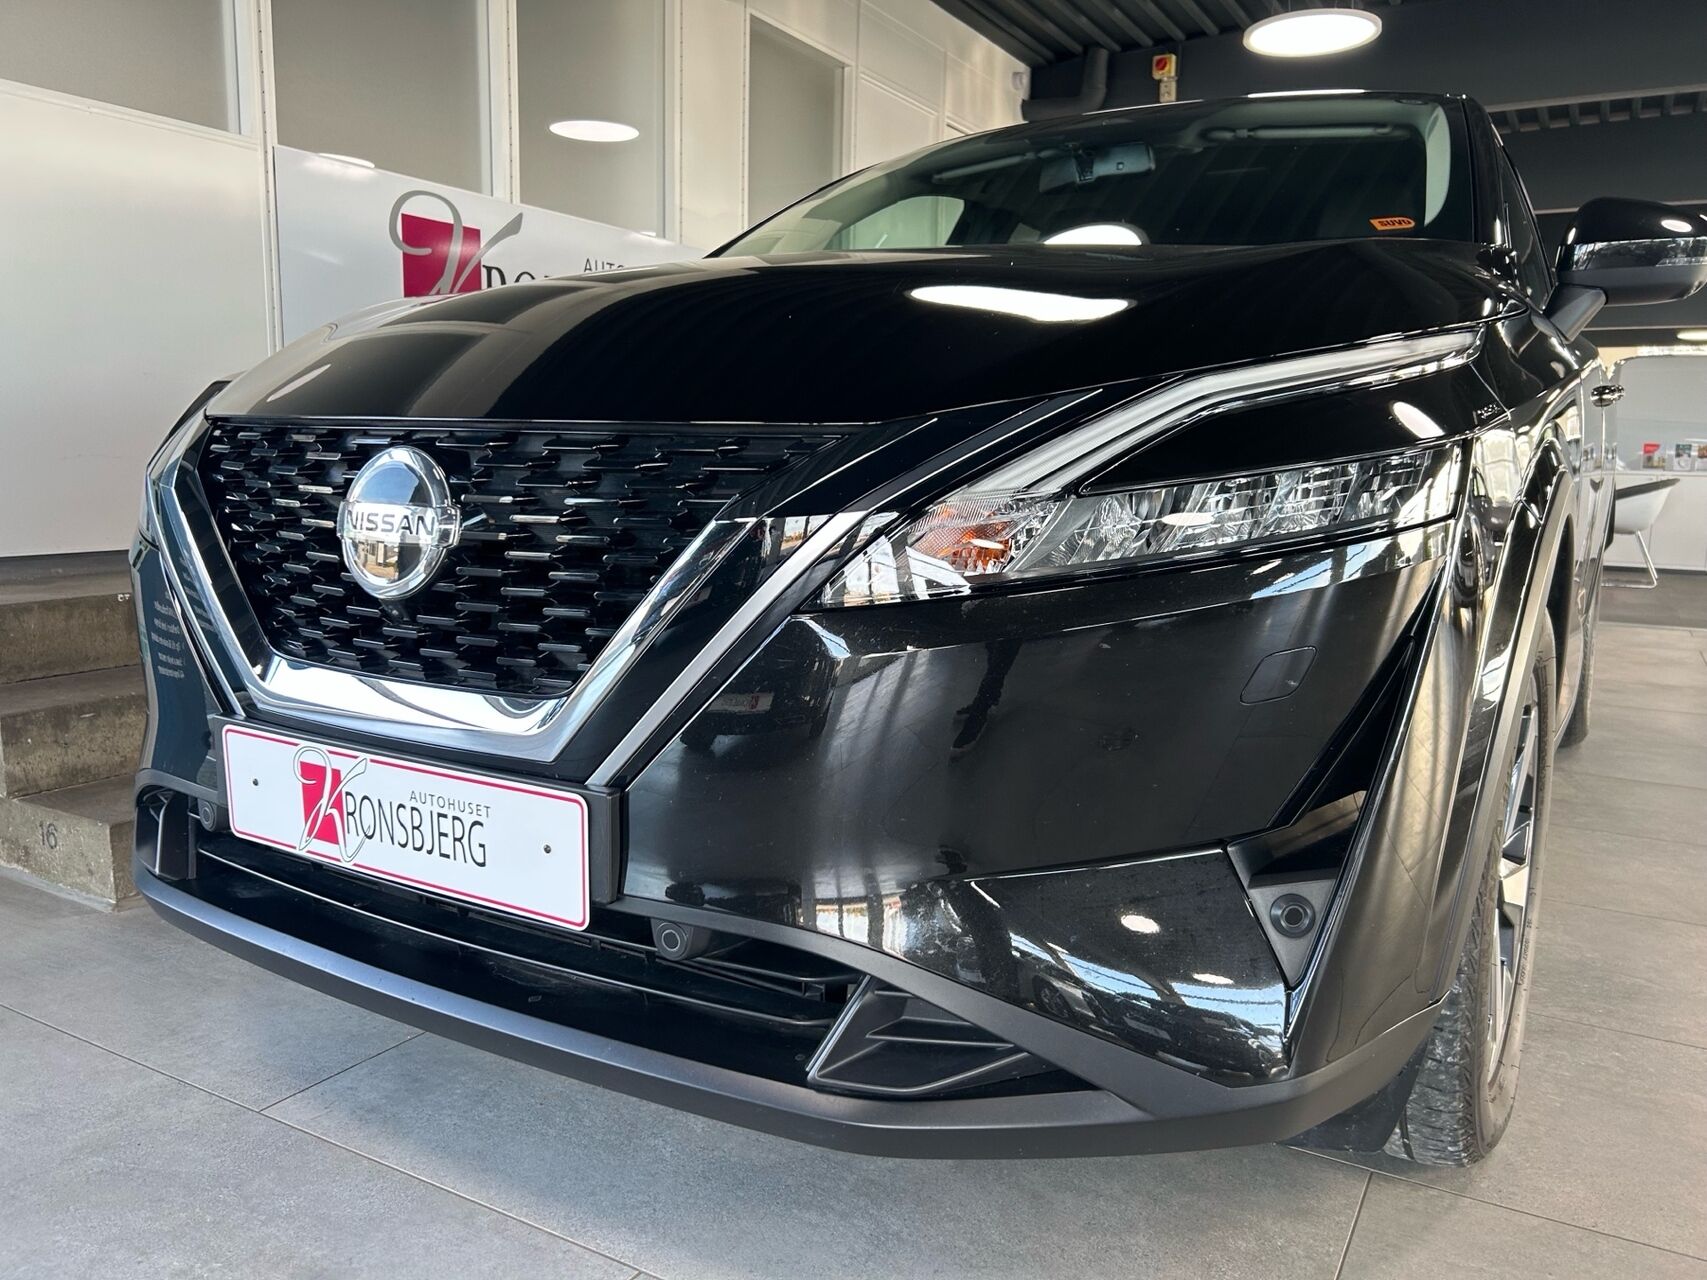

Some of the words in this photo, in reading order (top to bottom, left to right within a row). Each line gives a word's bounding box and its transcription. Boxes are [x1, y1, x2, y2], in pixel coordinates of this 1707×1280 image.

[346, 509, 435, 536] NISSAN
[293, 746, 487, 868] KRONSBJERG
[409, 790, 491, 818] AUTOHUSET
[39, 821, 58, 849] 16
